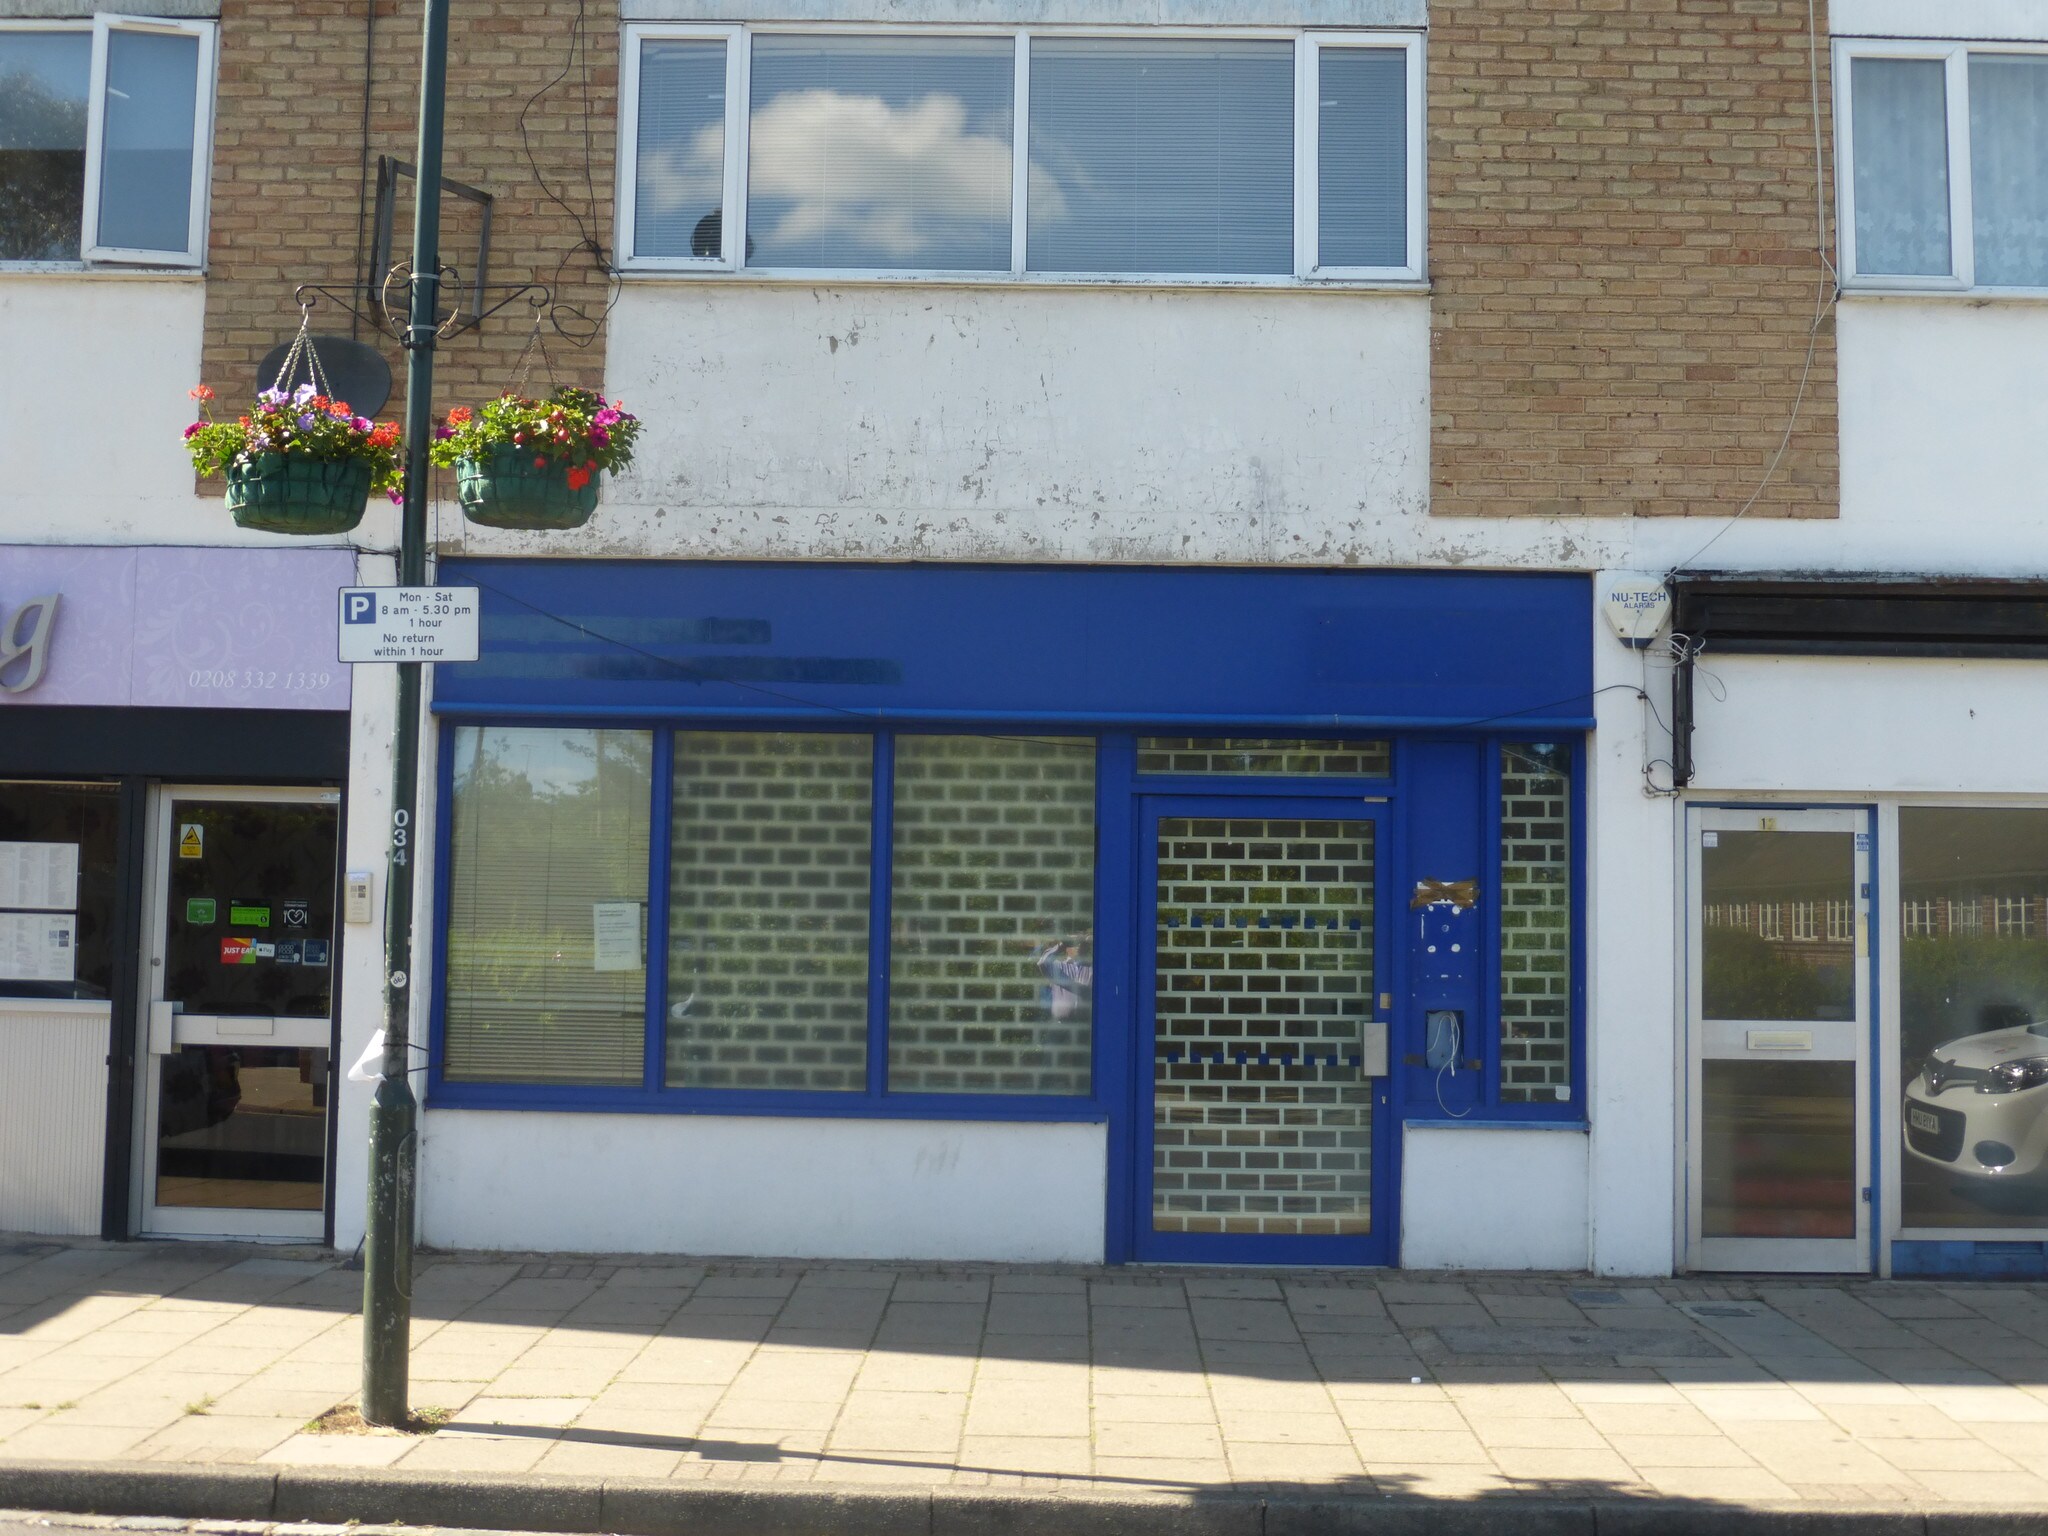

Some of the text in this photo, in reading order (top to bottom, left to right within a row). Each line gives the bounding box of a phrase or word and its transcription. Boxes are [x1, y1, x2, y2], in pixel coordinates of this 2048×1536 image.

[399, 592, 422, 602] Mon
[435, 592, 453, 602] Sat
[1612, 592, 1666, 602] NU-TECH
[351, 596, 370, 621] P
[382, 606, 389, 614] 8
[422, 605, 450, 615] 5.30
[454, 606, 471, 616] pm
[409, 618, 442, 627] 1 hour
[383, 634, 435, 643] No return
[374, 646, 444, 656] within 1 hour
[189, 670, 330, 690] 0208 332 1339
[393, 808, 409, 866] 034
